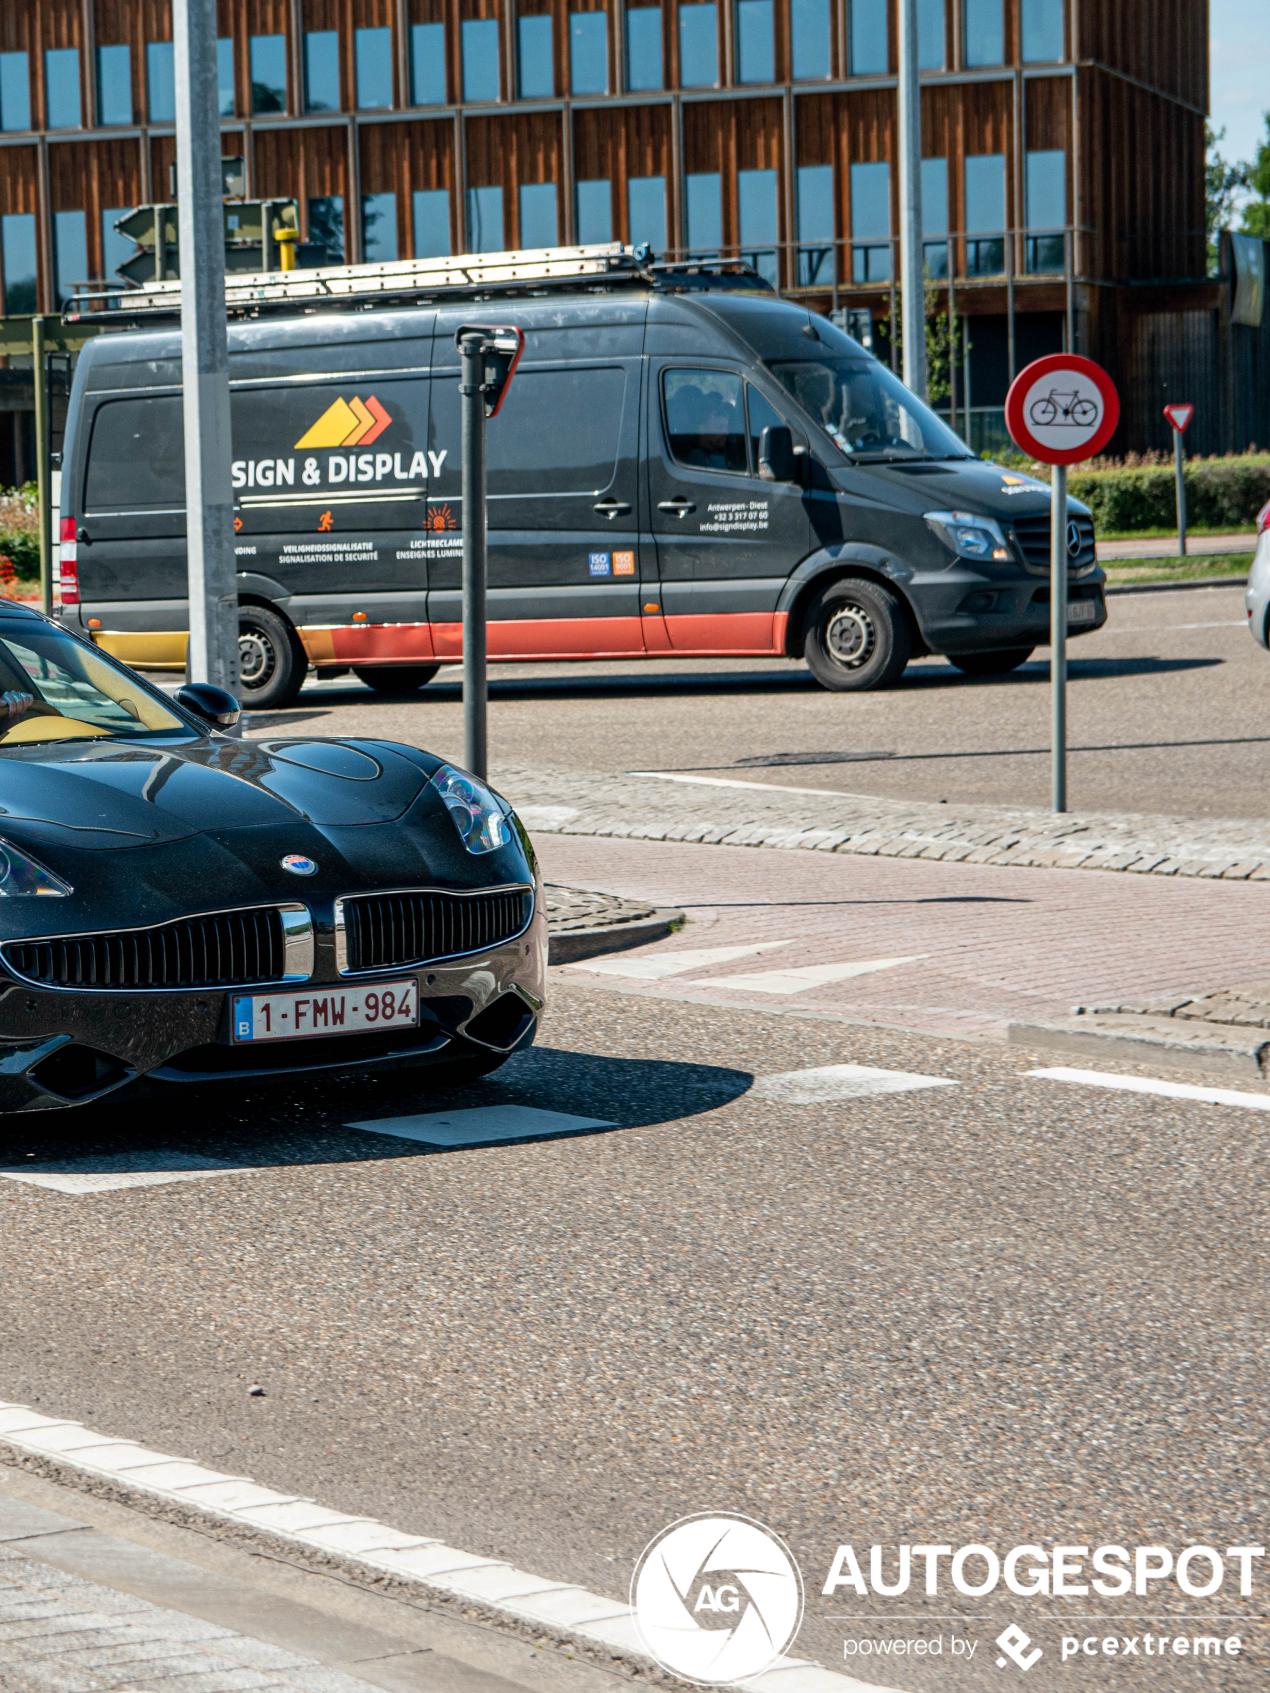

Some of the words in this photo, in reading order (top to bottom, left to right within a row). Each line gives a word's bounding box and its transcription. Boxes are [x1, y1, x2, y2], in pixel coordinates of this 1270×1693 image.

[232, 458, 295, 488] SIGN
[302, 457, 321, 485] &
[329, 450, 448, 483] DISPLAY
[749, 501, 768, 510] Diest
[713, 512, 727, 521] +32
[728, 512, 733, 521] 3
[734, 511, 747, 520] 317
[748, 511, 758, 520] 07
[758, 510, 768, 519] 60
[699, 521, 768, 532] info@signdisplay.be
[283, 542, 374, 554] VEILIGHEIDSSIGNALISATIE
[279, 552, 333, 564] SIGNALISATION
[334, 552, 344, 562] DE
[396, 549, 435, 560] ENSEIGNES
[591, 553, 607, 564] ISO
[615, 553, 631, 563] ISO
[260, 989, 411, 1032] 1-FMW-984
[239, 1022, 249, 1035] B
